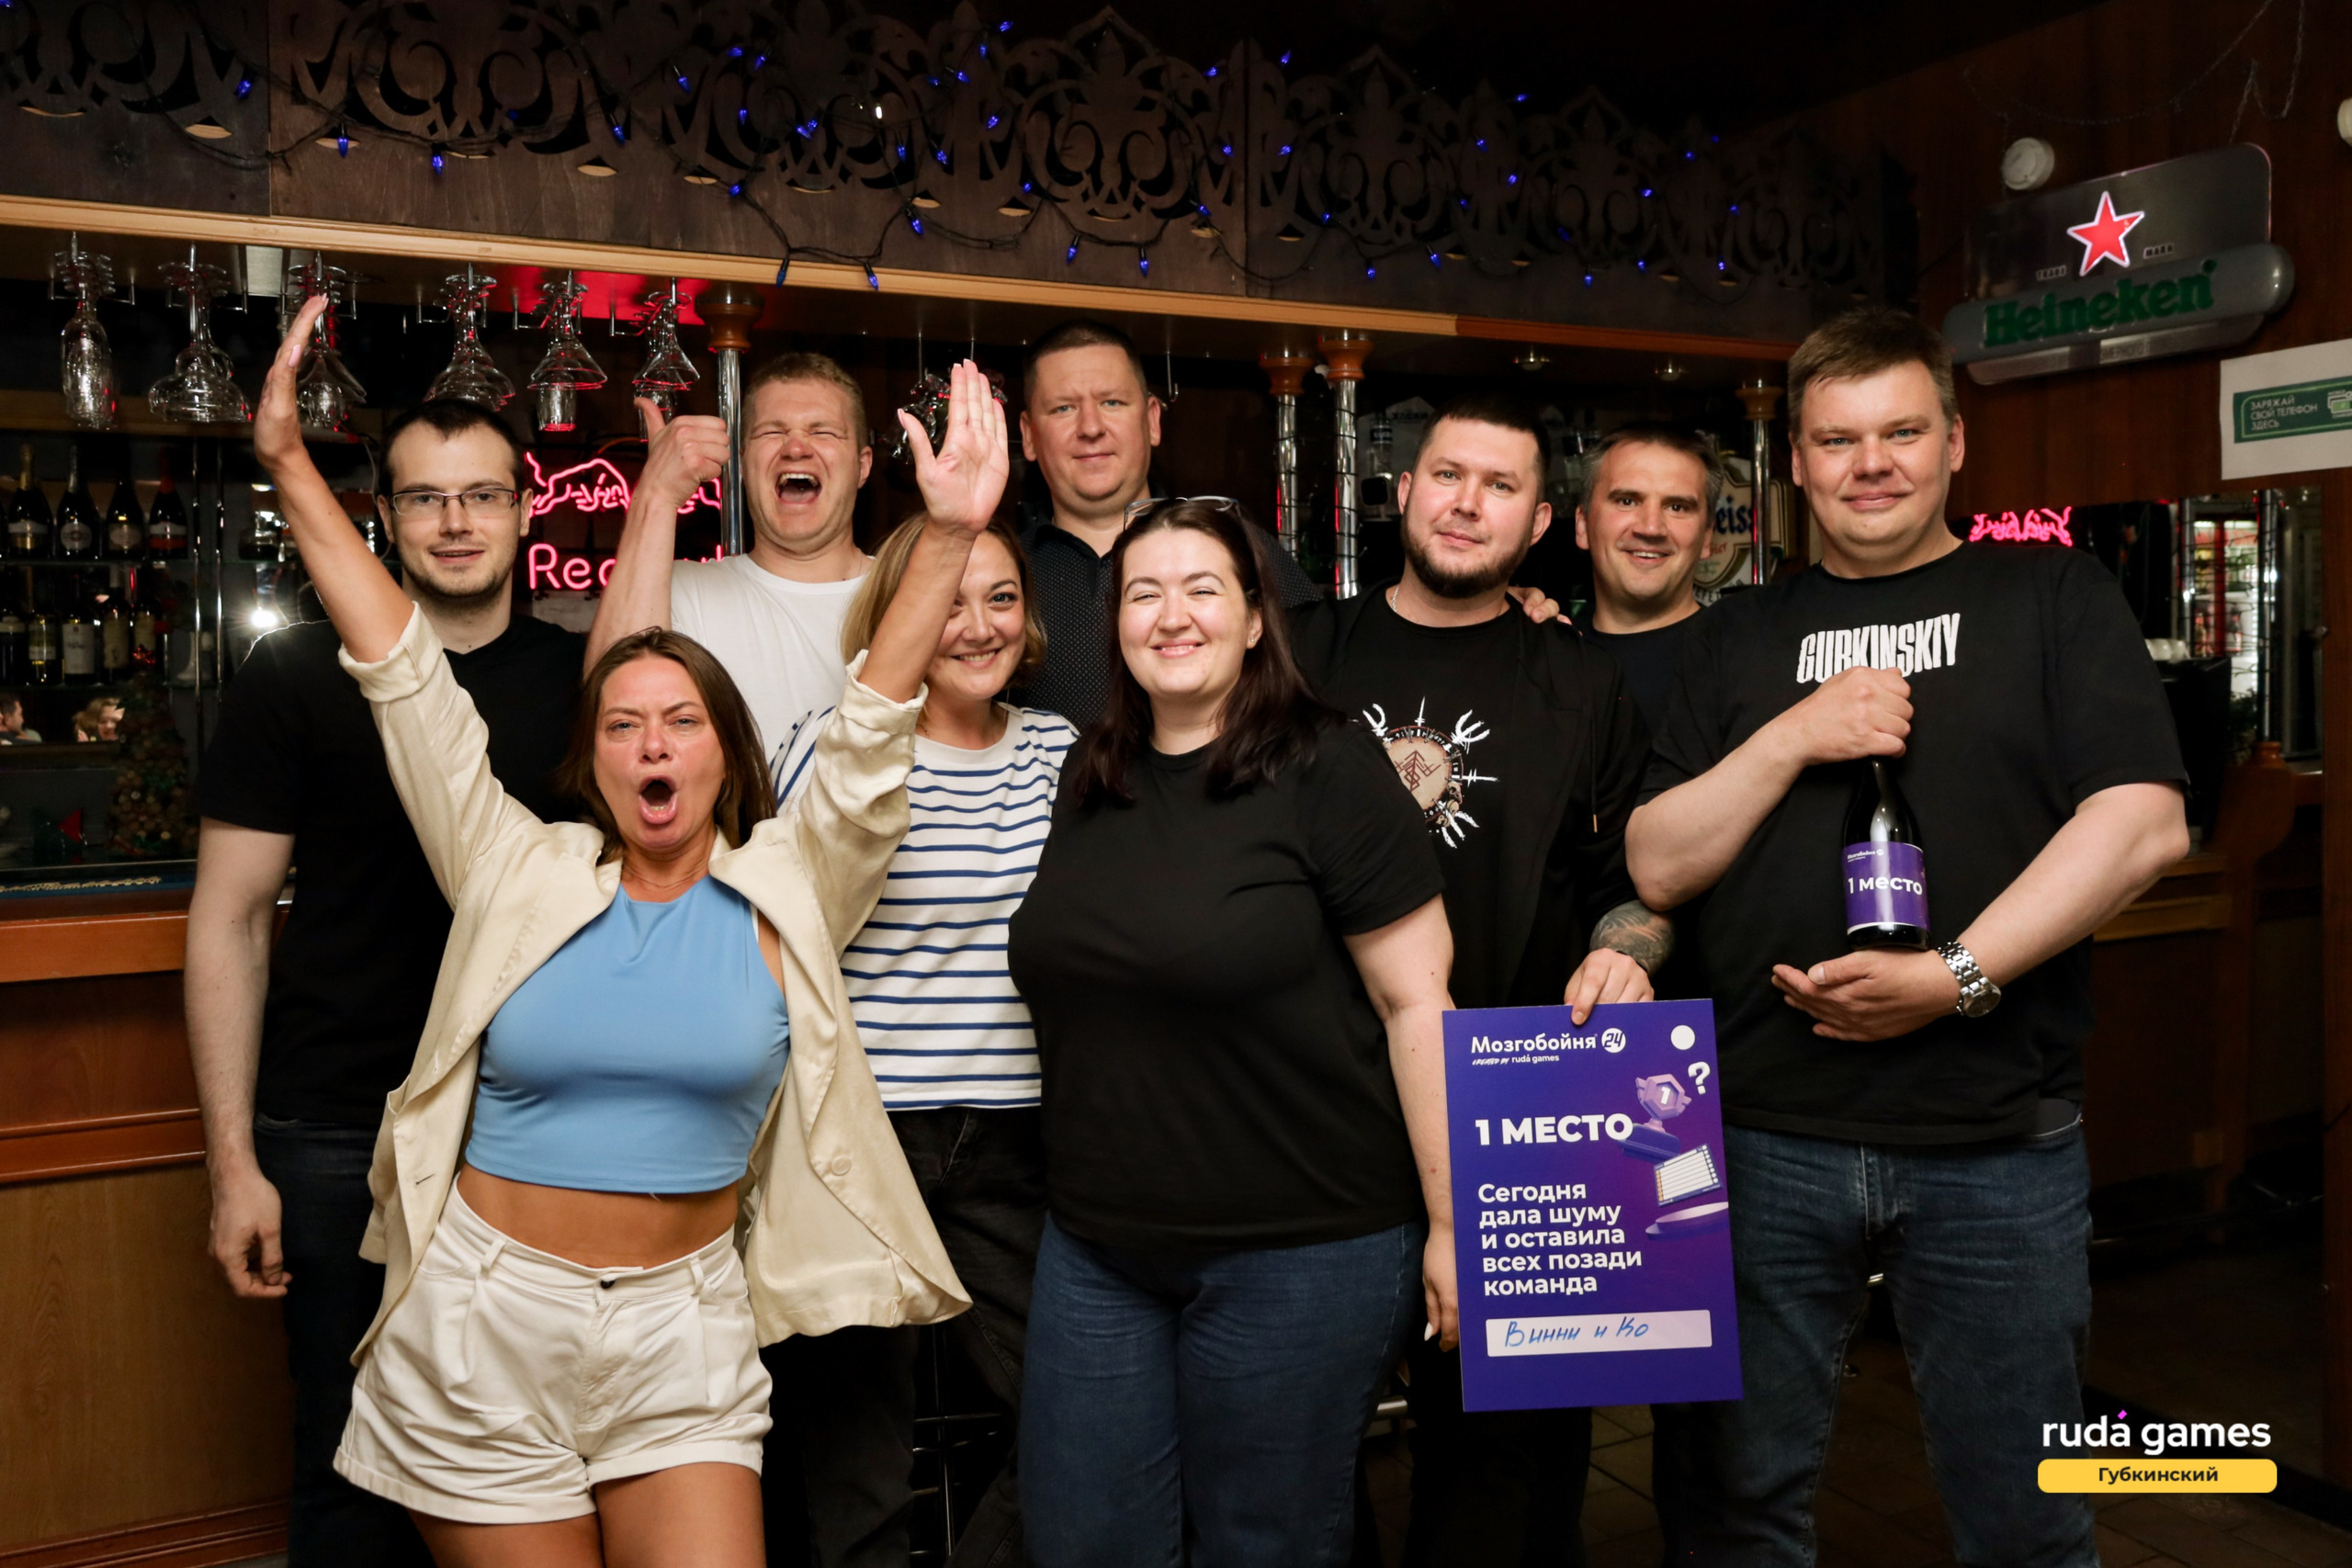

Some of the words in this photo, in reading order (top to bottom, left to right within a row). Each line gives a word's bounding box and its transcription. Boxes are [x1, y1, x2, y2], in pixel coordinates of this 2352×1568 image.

[2143, 243, 2175, 258] MARK
[1984, 275, 2213, 347] Heineken
[2251, 395, 2295, 410] ЗАРЯЖАЙ
[2251, 409, 2275, 421] СВОЙ
[2277, 404, 2318, 417] ТЕЛЕФОН
[2252, 419, 2279, 431] ЗДЕСЬ
[1796, 613, 1962, 683] GUBKINSKIY
[1848, 877, 1855, 895] 1
[1859, 876, 1924, 896] место
[1471, 1032, 1597, 1054] Мозгобойня
[1602, 1031, 1625, 1050] 24
[1532, 1055, 1560, 1065] games
[1475, 1118, 1491, 1145] 1
[1501, 1112, 1634, 1145] МЕСТО
[1477, 1183, 1587, 1203] Сегодня
[1479, 1209, 1542, 1229] дала
[1549, 1204, 1623, 1227] шуму
[1481, 1233, 1498, 1250] и
[1504, 1225, 1625, 1248] оставила
[1482, 1254, 1542, 1273] всех
[1548, 1249, 1643, 1271] позади
[1484, 1276, 1598, 1296] команда
[1504, 1320, 1581, 1348] Винни
[1594, 1325, 1609, 1339] и
[1616, 1316, 1650, 1339] Ко
